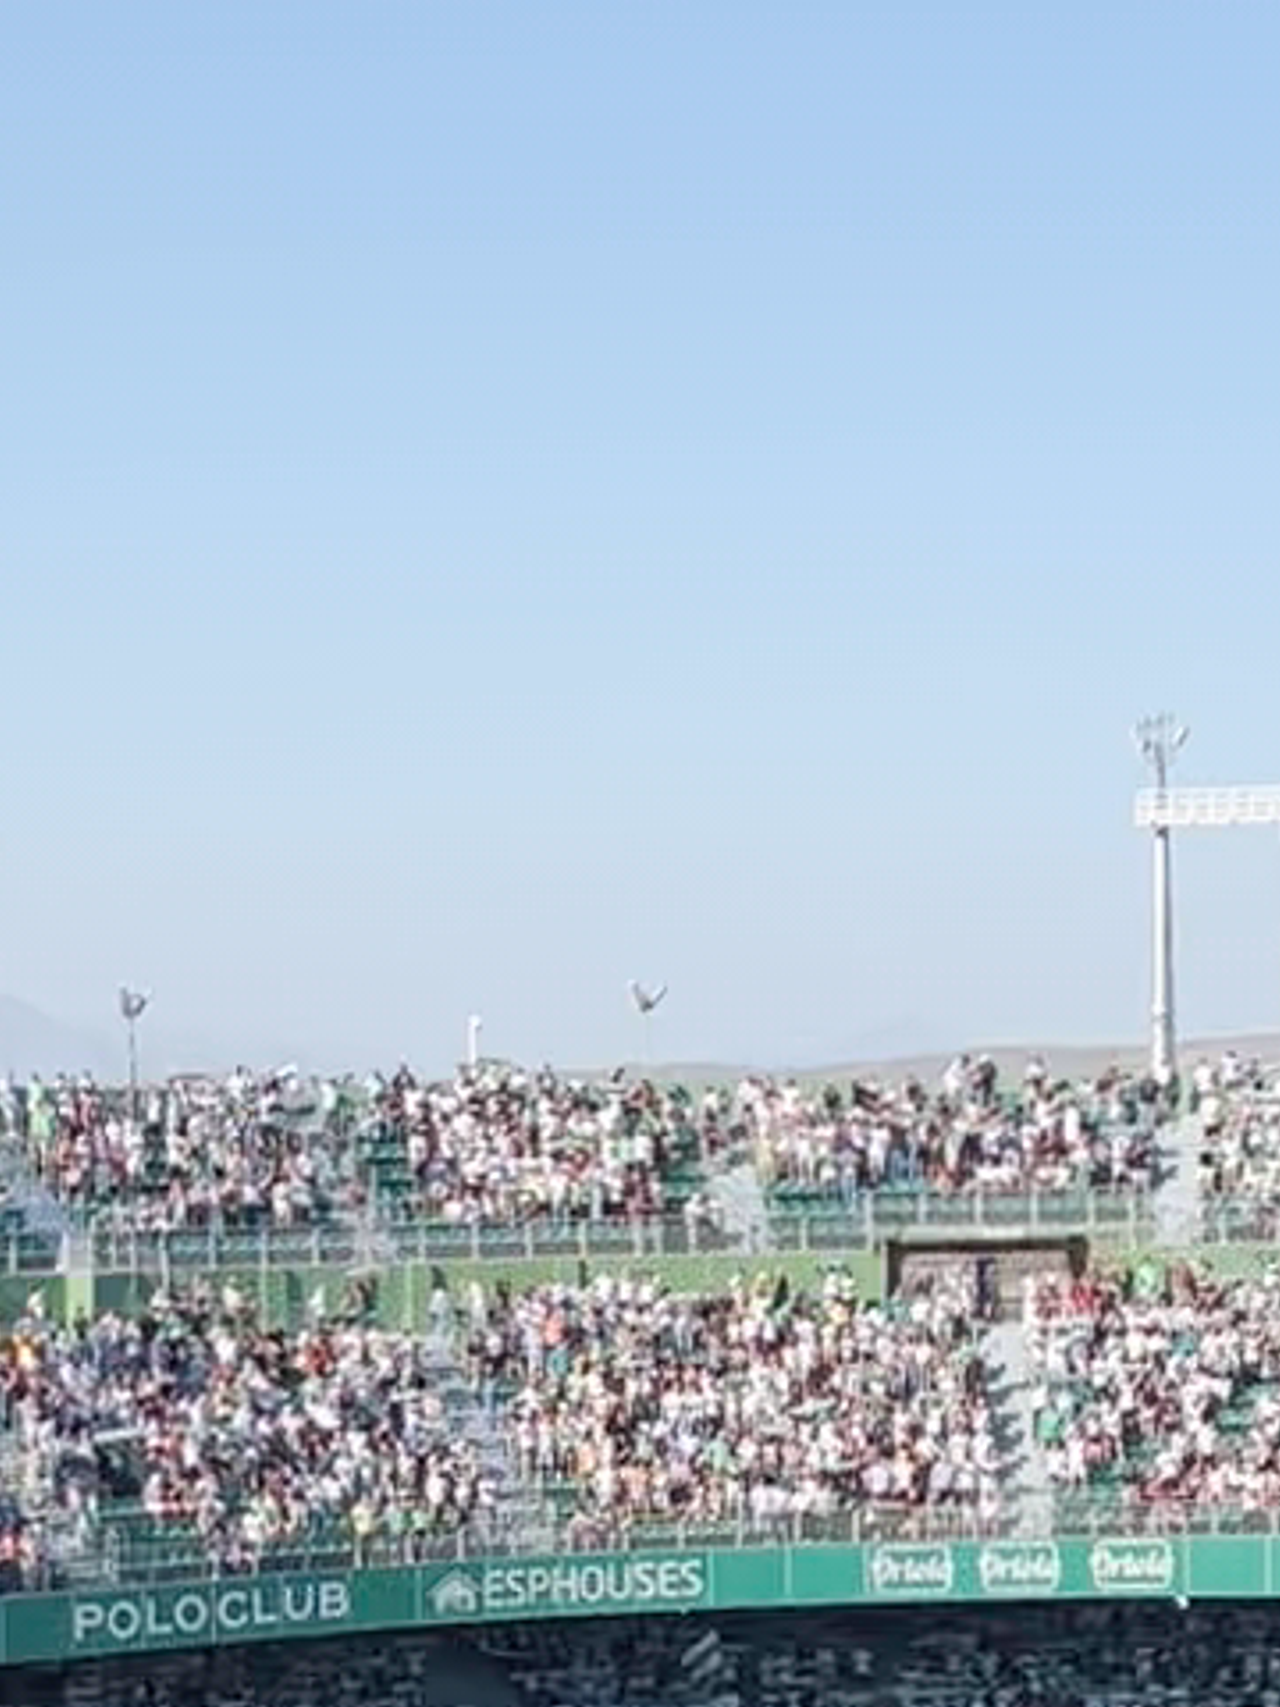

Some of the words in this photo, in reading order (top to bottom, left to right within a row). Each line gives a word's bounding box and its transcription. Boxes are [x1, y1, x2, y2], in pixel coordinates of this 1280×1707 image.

[483, 1558, 704, 1608] ESPHOUSES
[73, 1594, 207, 1641] POLO
[220, 1581, 351, 1630] CLUB
